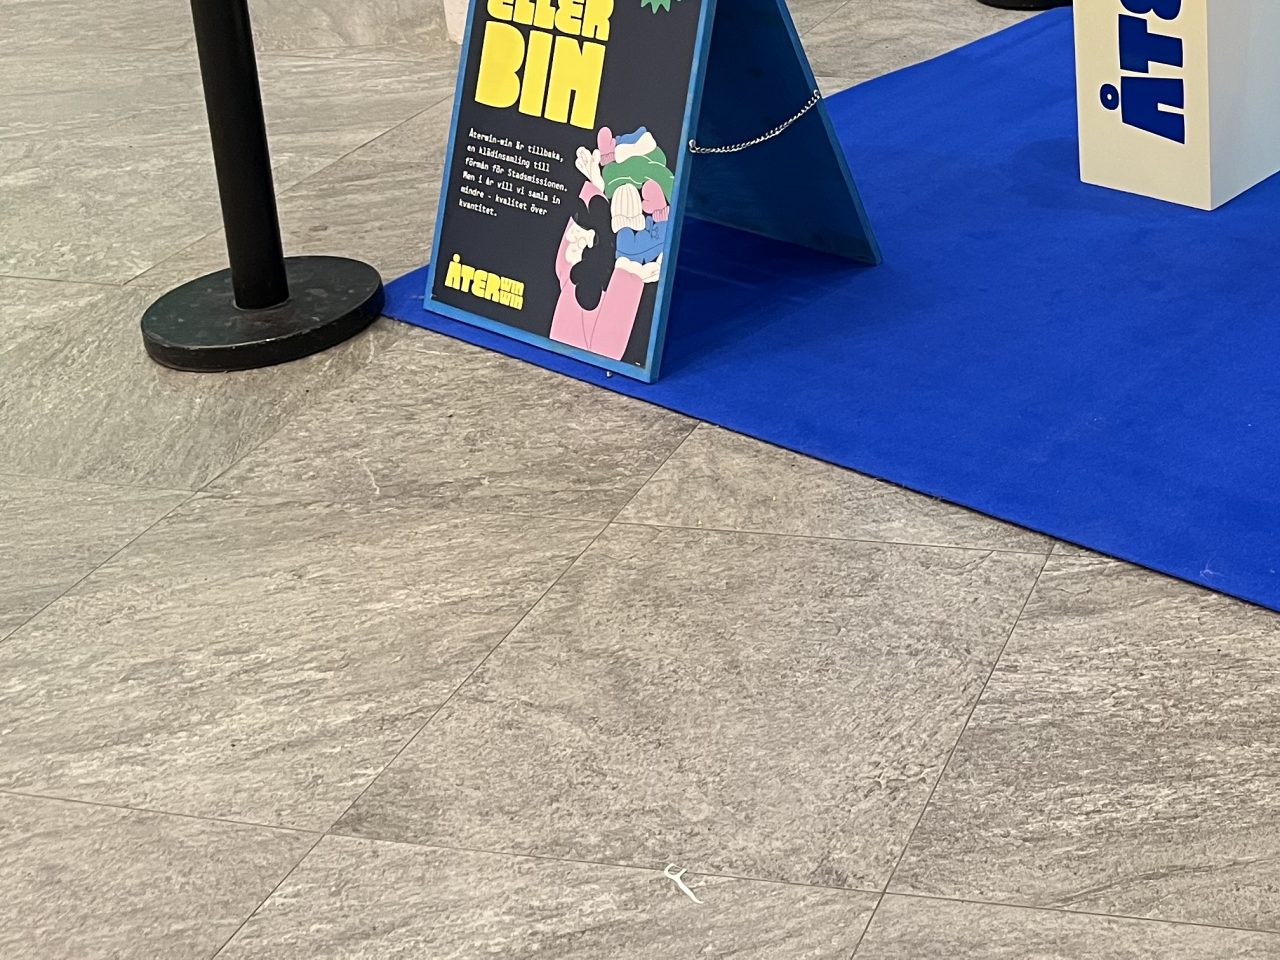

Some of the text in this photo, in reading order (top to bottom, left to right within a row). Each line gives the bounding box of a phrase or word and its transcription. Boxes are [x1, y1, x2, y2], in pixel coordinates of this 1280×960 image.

[474, 20, 606, 130] BIN
[467, 145, 550, 173] en klädinsamling till
[515, 140, 525, 151] är
[528, 145, 564, 163] tillbaka,
[462, 170, 475, 181] Men
[485, 175, 494, 185] år
[497, 181, 513, 192] vill
[516, 186, 525, 195] vi
[528, 190, 549, 201] samla
[552, 195, 561, 205] in
[465, 157, 568, 192] förmån för Stadsmissionen.
[459, 198, 497, 217] kvantitet.
[460, 185, 484, 198] mindre
[495, 194, 527, 211] kvalitet
[530, 203, 548, 216] över
[444, 253, 525, 303] ÅTER WIN
